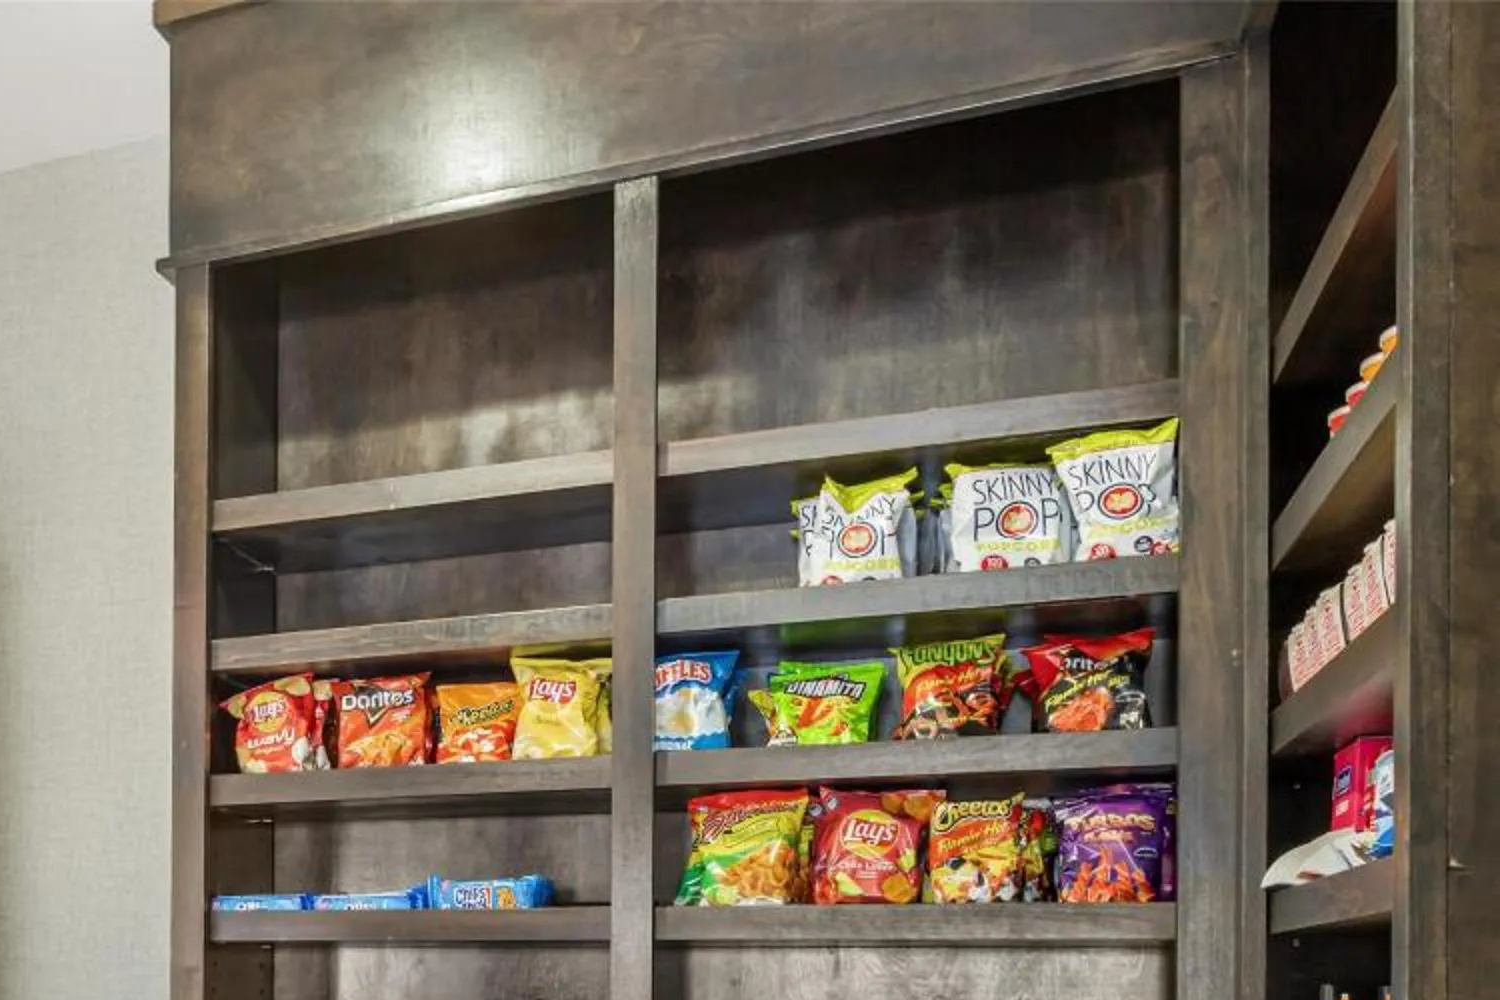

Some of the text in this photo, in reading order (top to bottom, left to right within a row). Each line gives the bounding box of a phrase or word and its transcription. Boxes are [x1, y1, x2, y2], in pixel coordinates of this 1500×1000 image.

[1067, 454, 1157, 491] SKINNY
[972, 472, 1054, 505] SKINNY
[973, 497, 1060, 541] POP
[341, 687, 415, 711] Doritos
[786, 680, 865, 700] DINAMITA
[933, 800, 1012, 829] Cheetos
